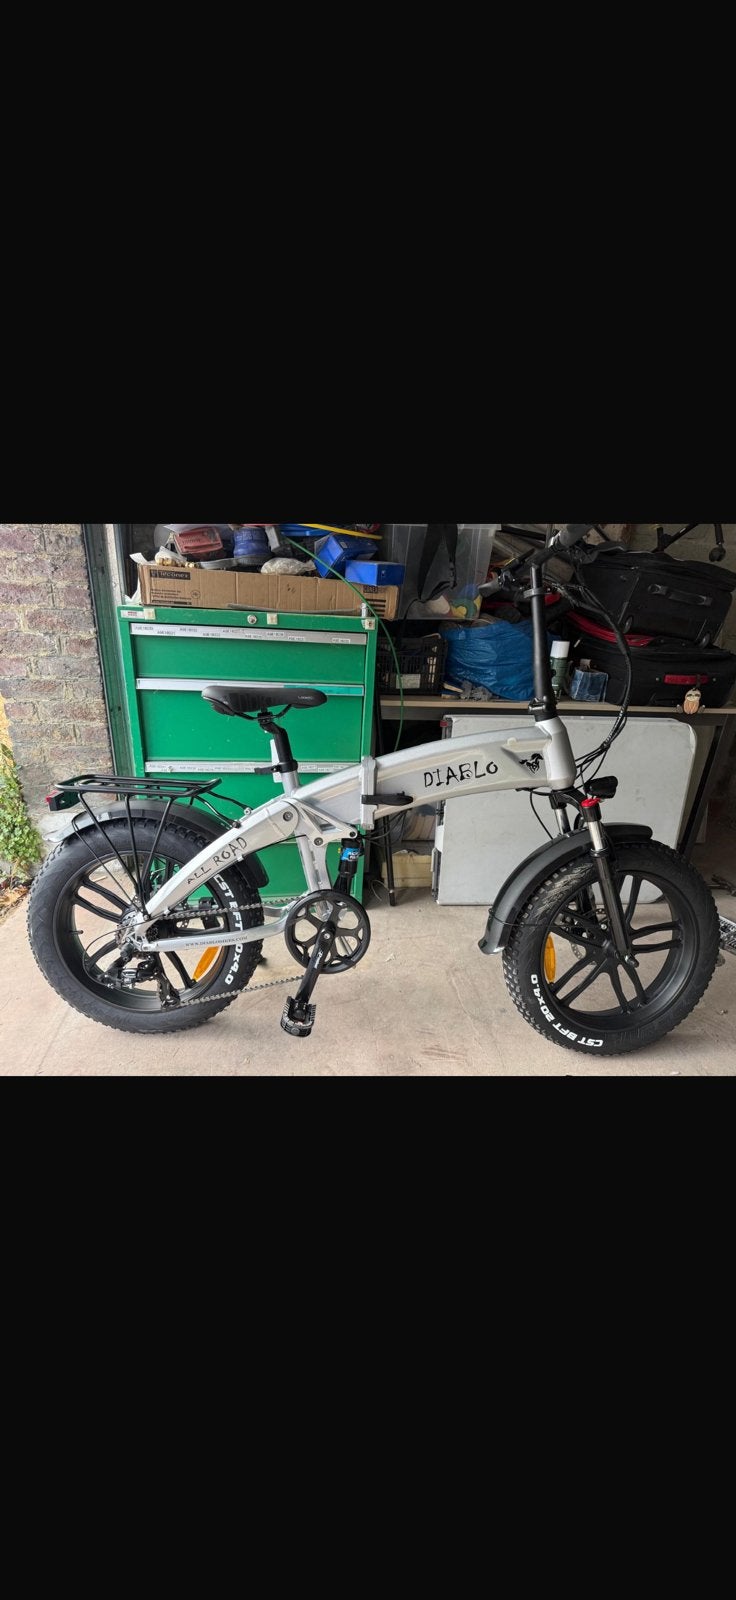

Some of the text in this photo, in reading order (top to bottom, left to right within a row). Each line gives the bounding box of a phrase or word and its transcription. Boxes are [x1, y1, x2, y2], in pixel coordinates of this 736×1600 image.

[423, 761, 498, 787] DIABLO
[187, 836, 247, 885] ALL ROAD
[213, 873, 234, 898] CST
[225, 943, 243, 985] 0x4.0
[552, 1022, 578, 1041] BFT
[577, 1037, 603, 1047] CST
